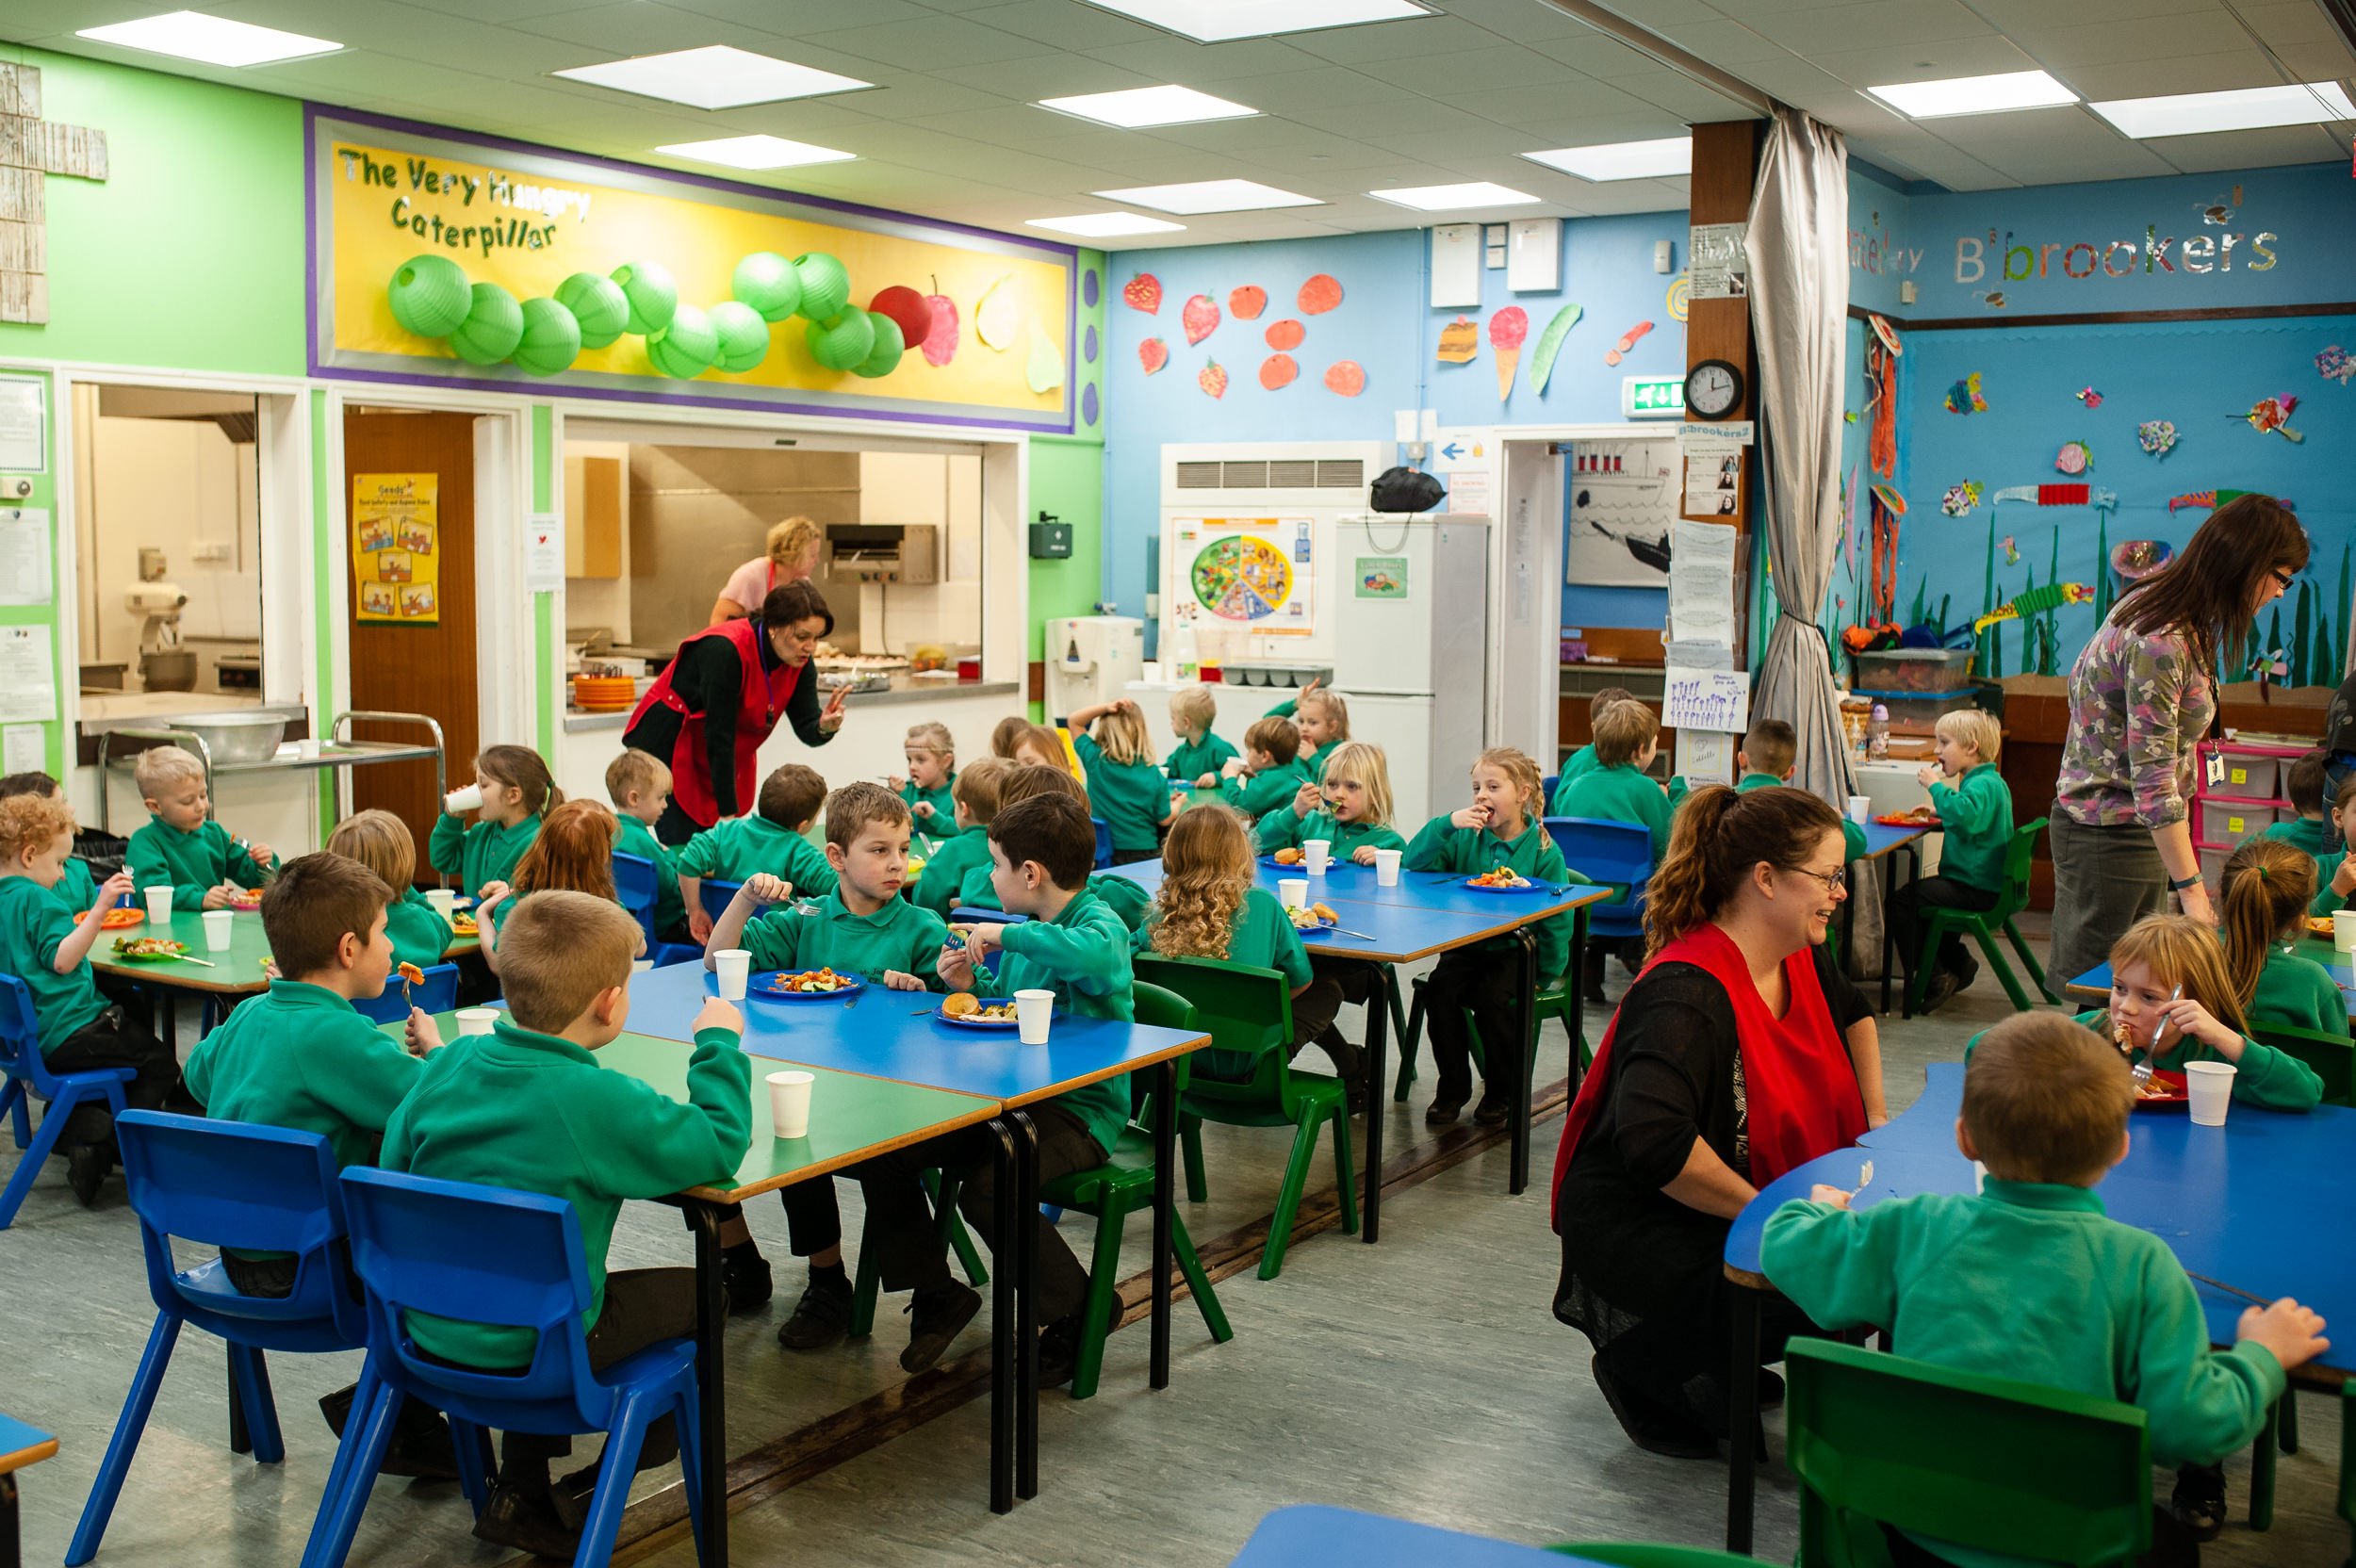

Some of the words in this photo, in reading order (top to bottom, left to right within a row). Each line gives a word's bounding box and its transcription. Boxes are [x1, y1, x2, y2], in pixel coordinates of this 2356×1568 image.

[338, 148, 398, 188] The
[407, 156, 480, 206] Very
[488, 170, 591, 223] Hungry
[391, 195, 556, 258] Caterpillar
[1955, 224, 2278, 283] B'brookers
